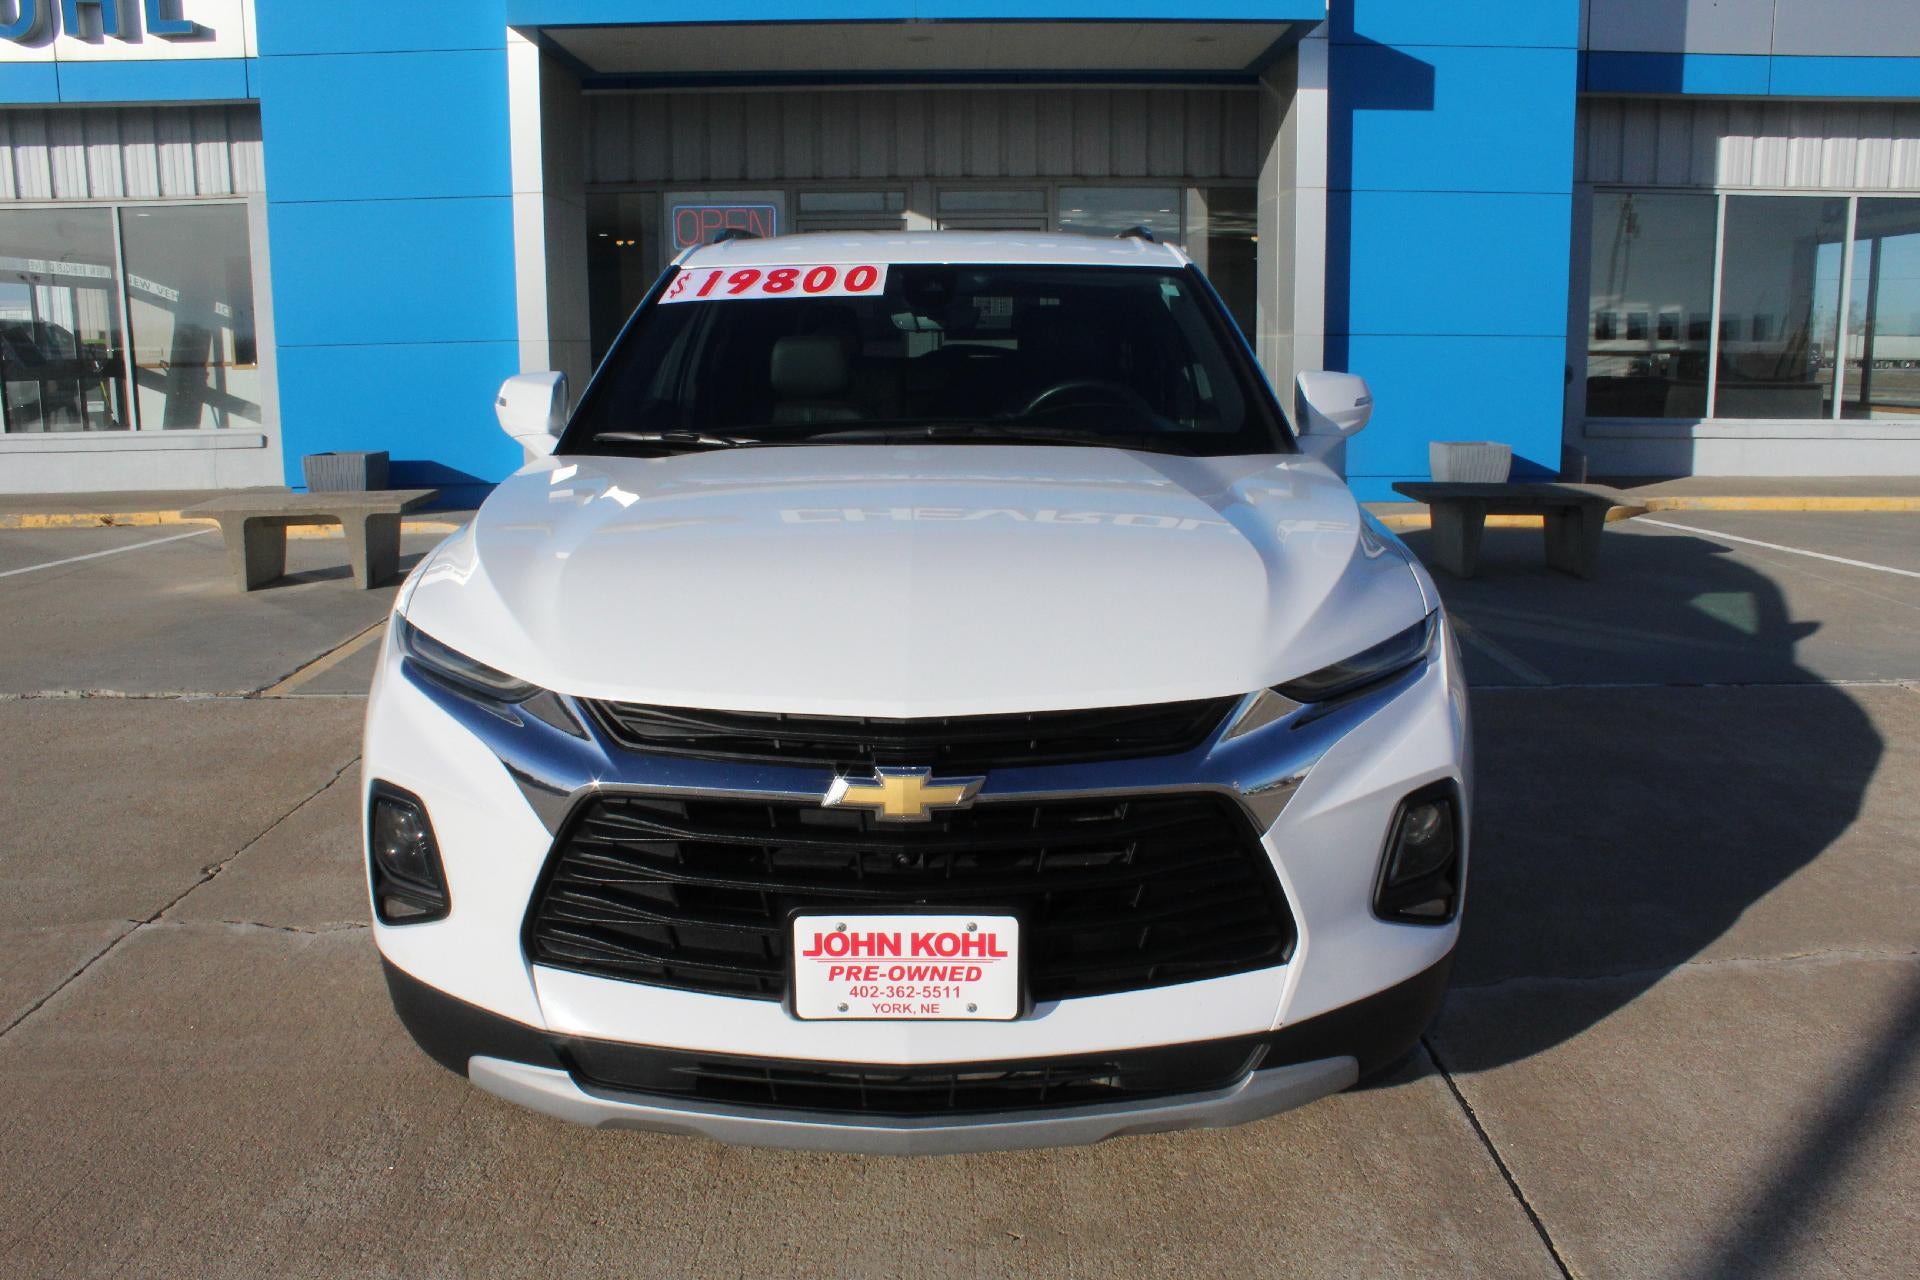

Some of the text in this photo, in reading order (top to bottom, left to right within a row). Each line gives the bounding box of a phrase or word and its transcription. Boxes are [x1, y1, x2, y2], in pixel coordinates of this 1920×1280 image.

[0, 0, 205, 43] HL
[676, 208, 772, 246] OPEN
[803, 933, 1008, 957] JOHN KOHL
[828, 965, 983, 982] PRE-OWNED
[849, 986, 960, 998] 402-362-5511
[872, 1003, 940, 1015] YORK, NE
